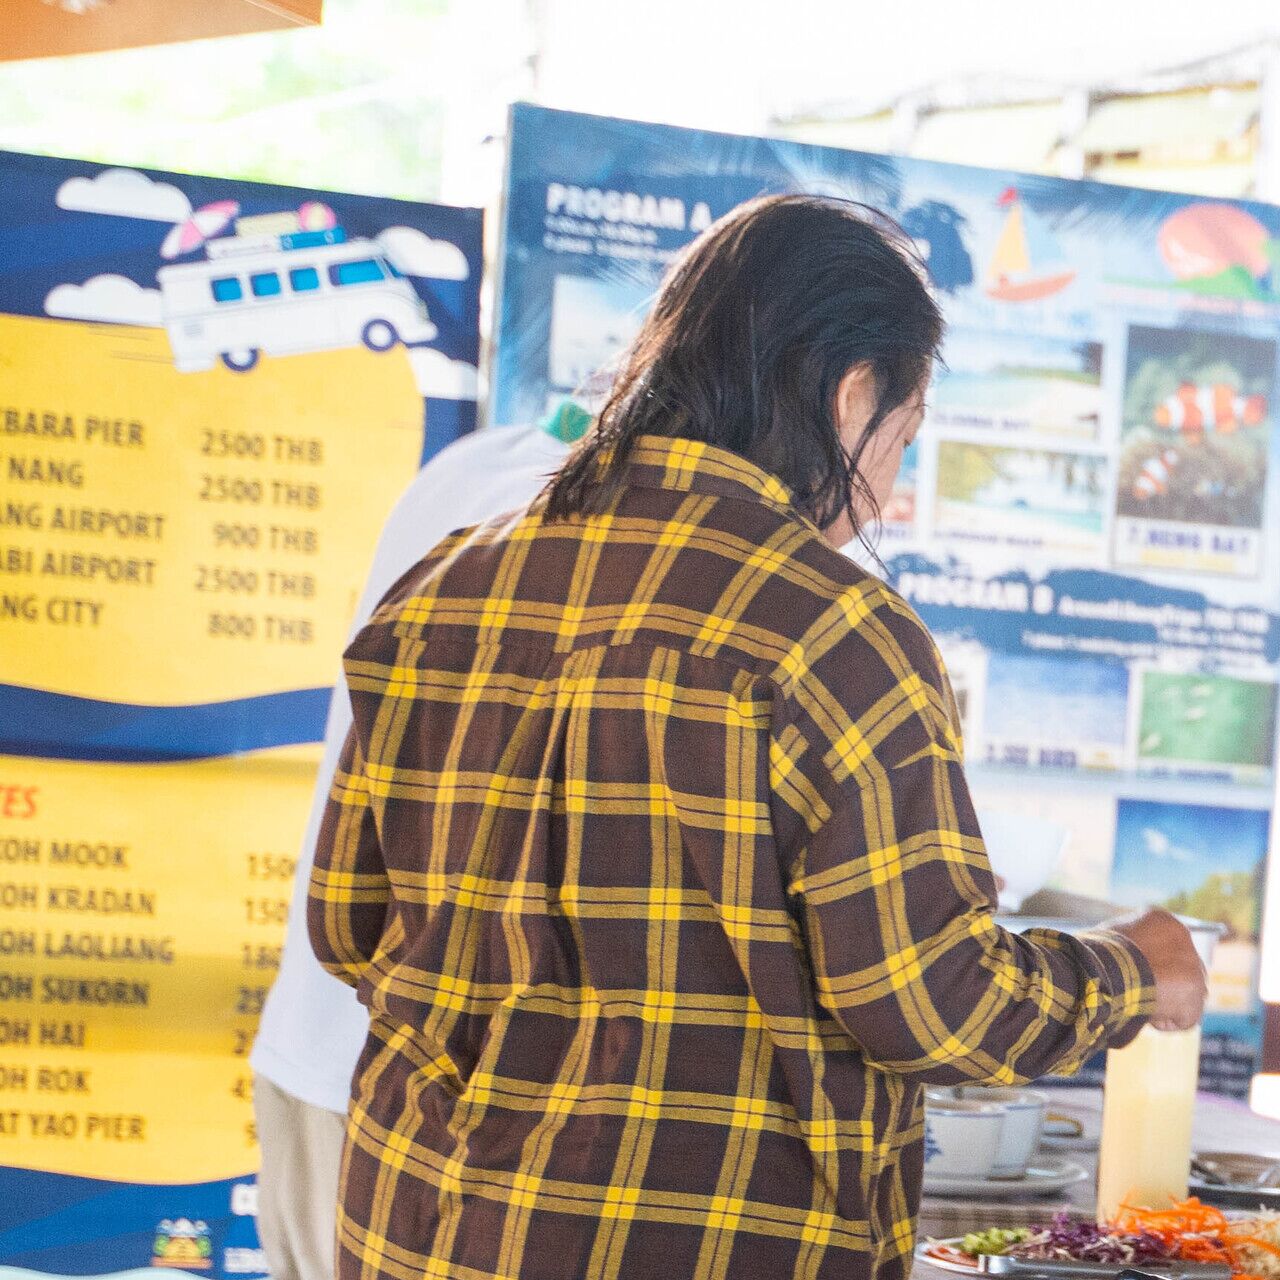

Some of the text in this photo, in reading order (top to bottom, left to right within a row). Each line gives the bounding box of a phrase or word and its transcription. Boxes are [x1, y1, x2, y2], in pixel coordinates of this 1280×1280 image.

[547, 182, 685, 232] PROGRAM
[689, 201, 712, 233] A
[0, 407, 323, 464] BARA PIER 2500 THB
[9, 457, 321, 509] NANG 2500 THB
[52, 506, 165, 541] AIRPORT
[213, 522, 260, 547] 900
[269, 526, 318, 554] THB
[0, 548, 33, 573] BI
[42, 552, 156, 585] AIRPORT
[266, 571, 316, 599] THB
[898, 571, 1028, 613] PROGRAM
[46, 597, 103, 625] CITY
[265, 615, 314, 643] THB
[50, 841, 129, 869] MOOK
[48, 887, 156, 916] KRADAN
[41, 975, 150, 1007] SUKORN
[39, 1021, 86, 1048] HAI
[37, 1068, 91, 1095] ROK
[30, 1113, 77, 1139] YAO
[86, 1115, 145, 1143] PIER
